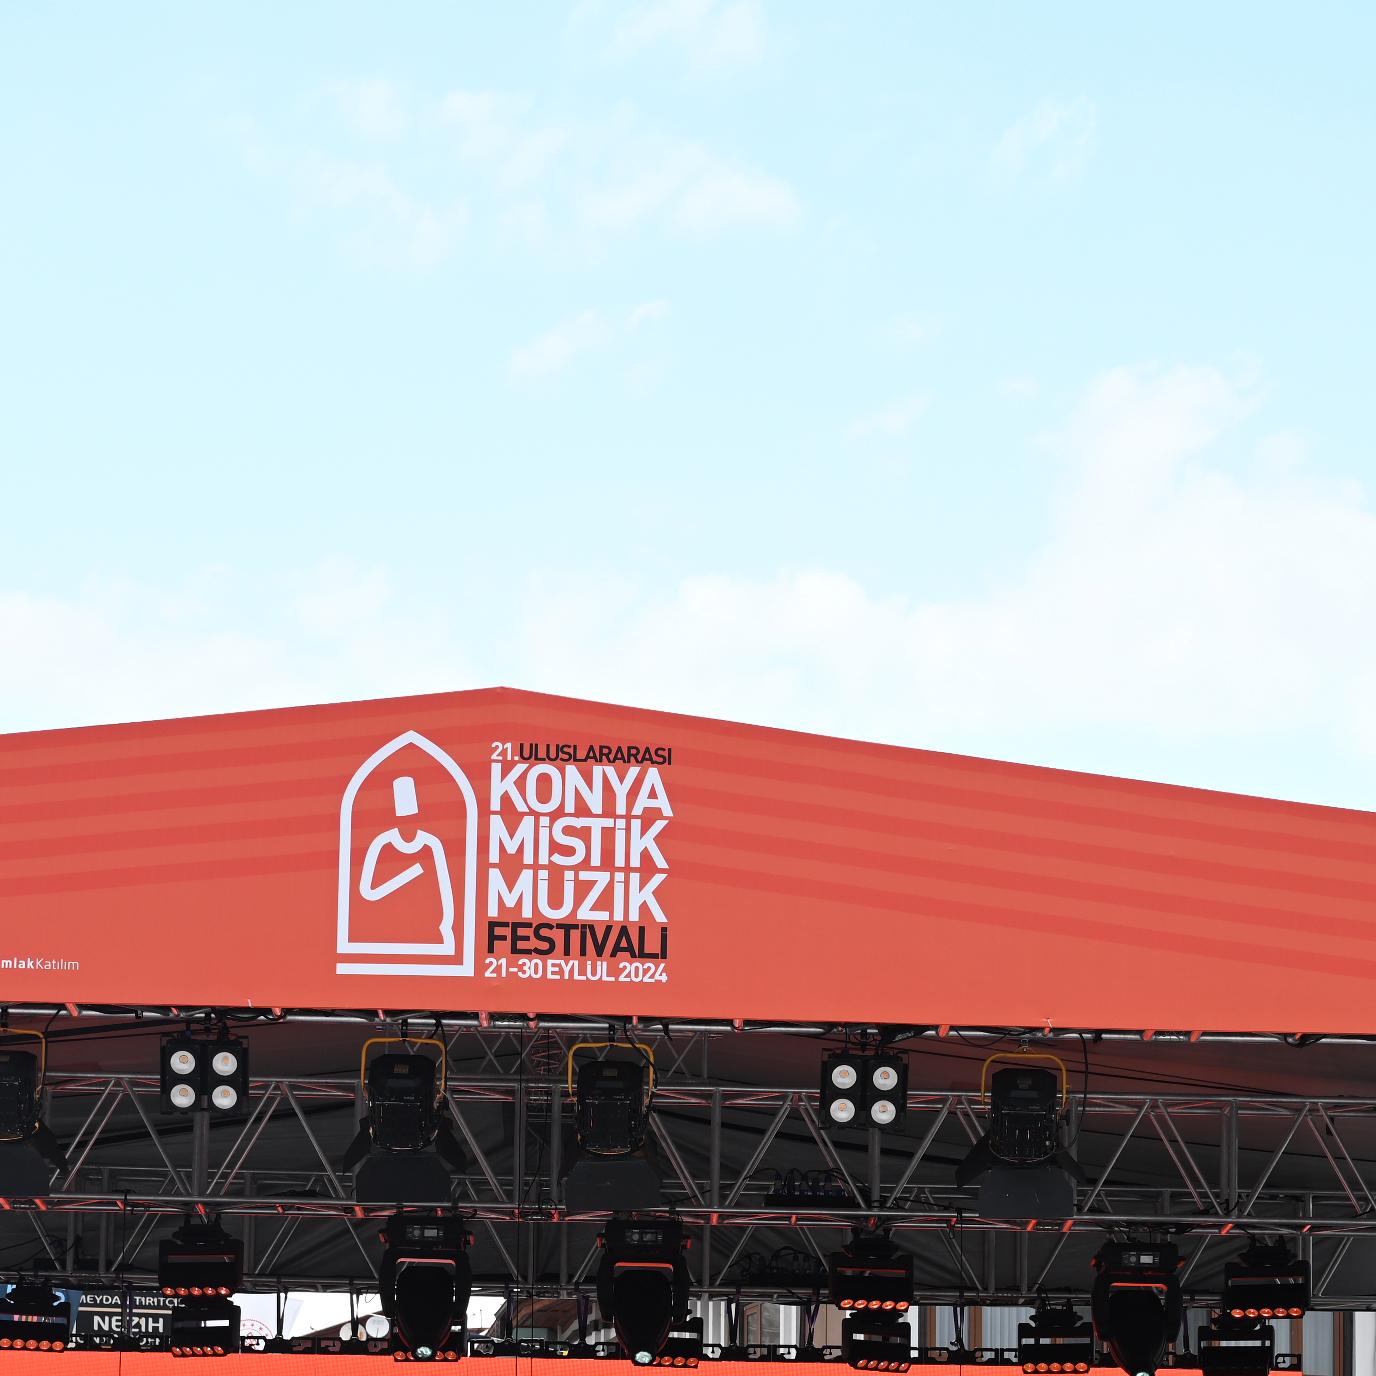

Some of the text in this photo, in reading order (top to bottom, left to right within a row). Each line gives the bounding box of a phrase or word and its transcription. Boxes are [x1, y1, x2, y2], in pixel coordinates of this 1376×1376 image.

[489, 762, 674, 817] KONYA
[484, 957, 542, 979] 21-30
[618, 961, 668, 984] 2024
